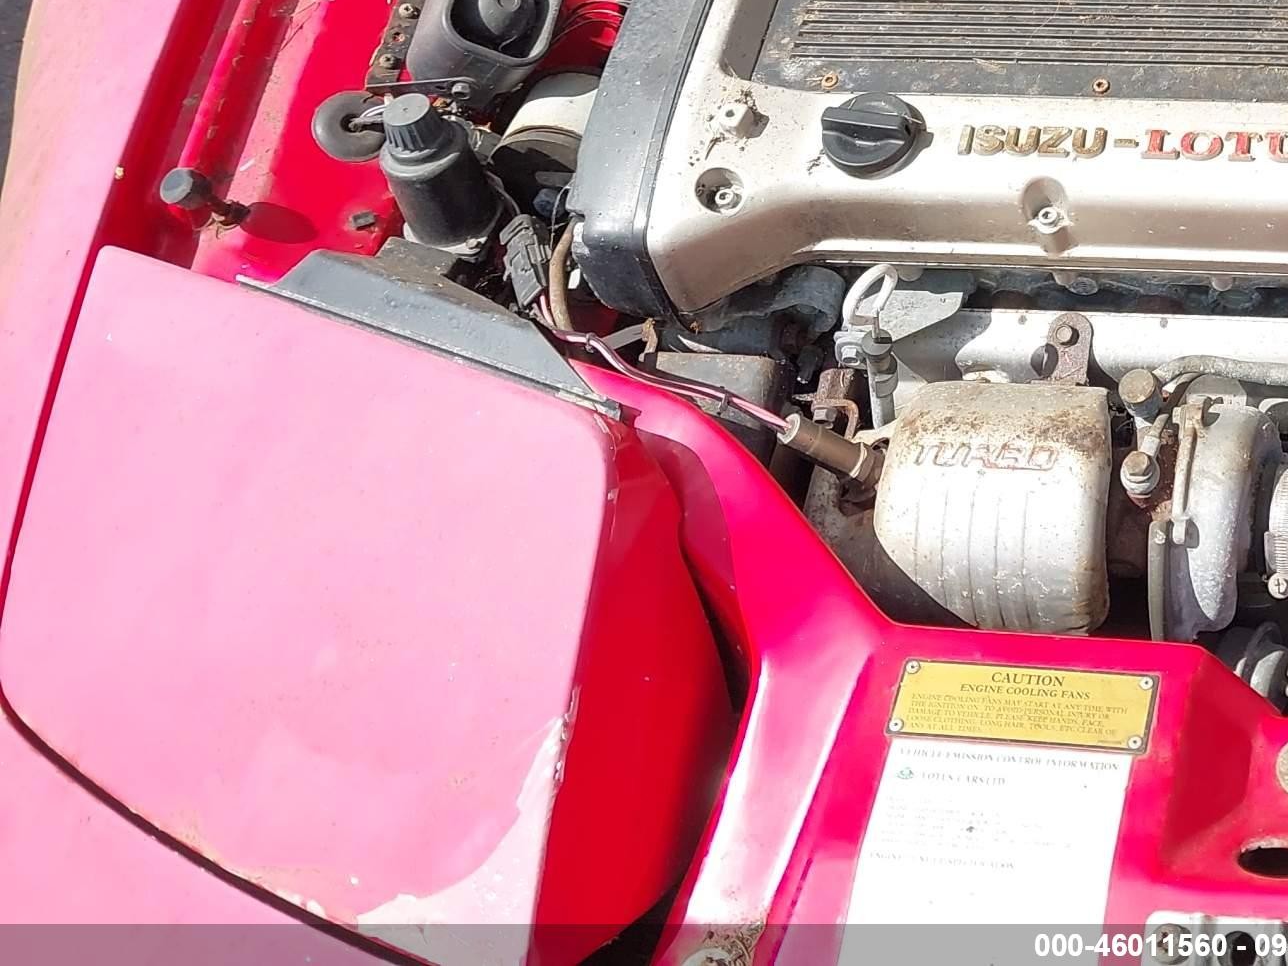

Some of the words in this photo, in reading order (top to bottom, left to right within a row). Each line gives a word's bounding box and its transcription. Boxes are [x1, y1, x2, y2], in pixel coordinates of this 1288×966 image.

[908, 437, 1059, 471] TURBO
[991, 672, 1065, 687] CAUTION
[960, 684, 1004, 694] ENGINE
[1006, 686, 1058, 698] COOLING
[1061, 690, 1091, 700] FANS
